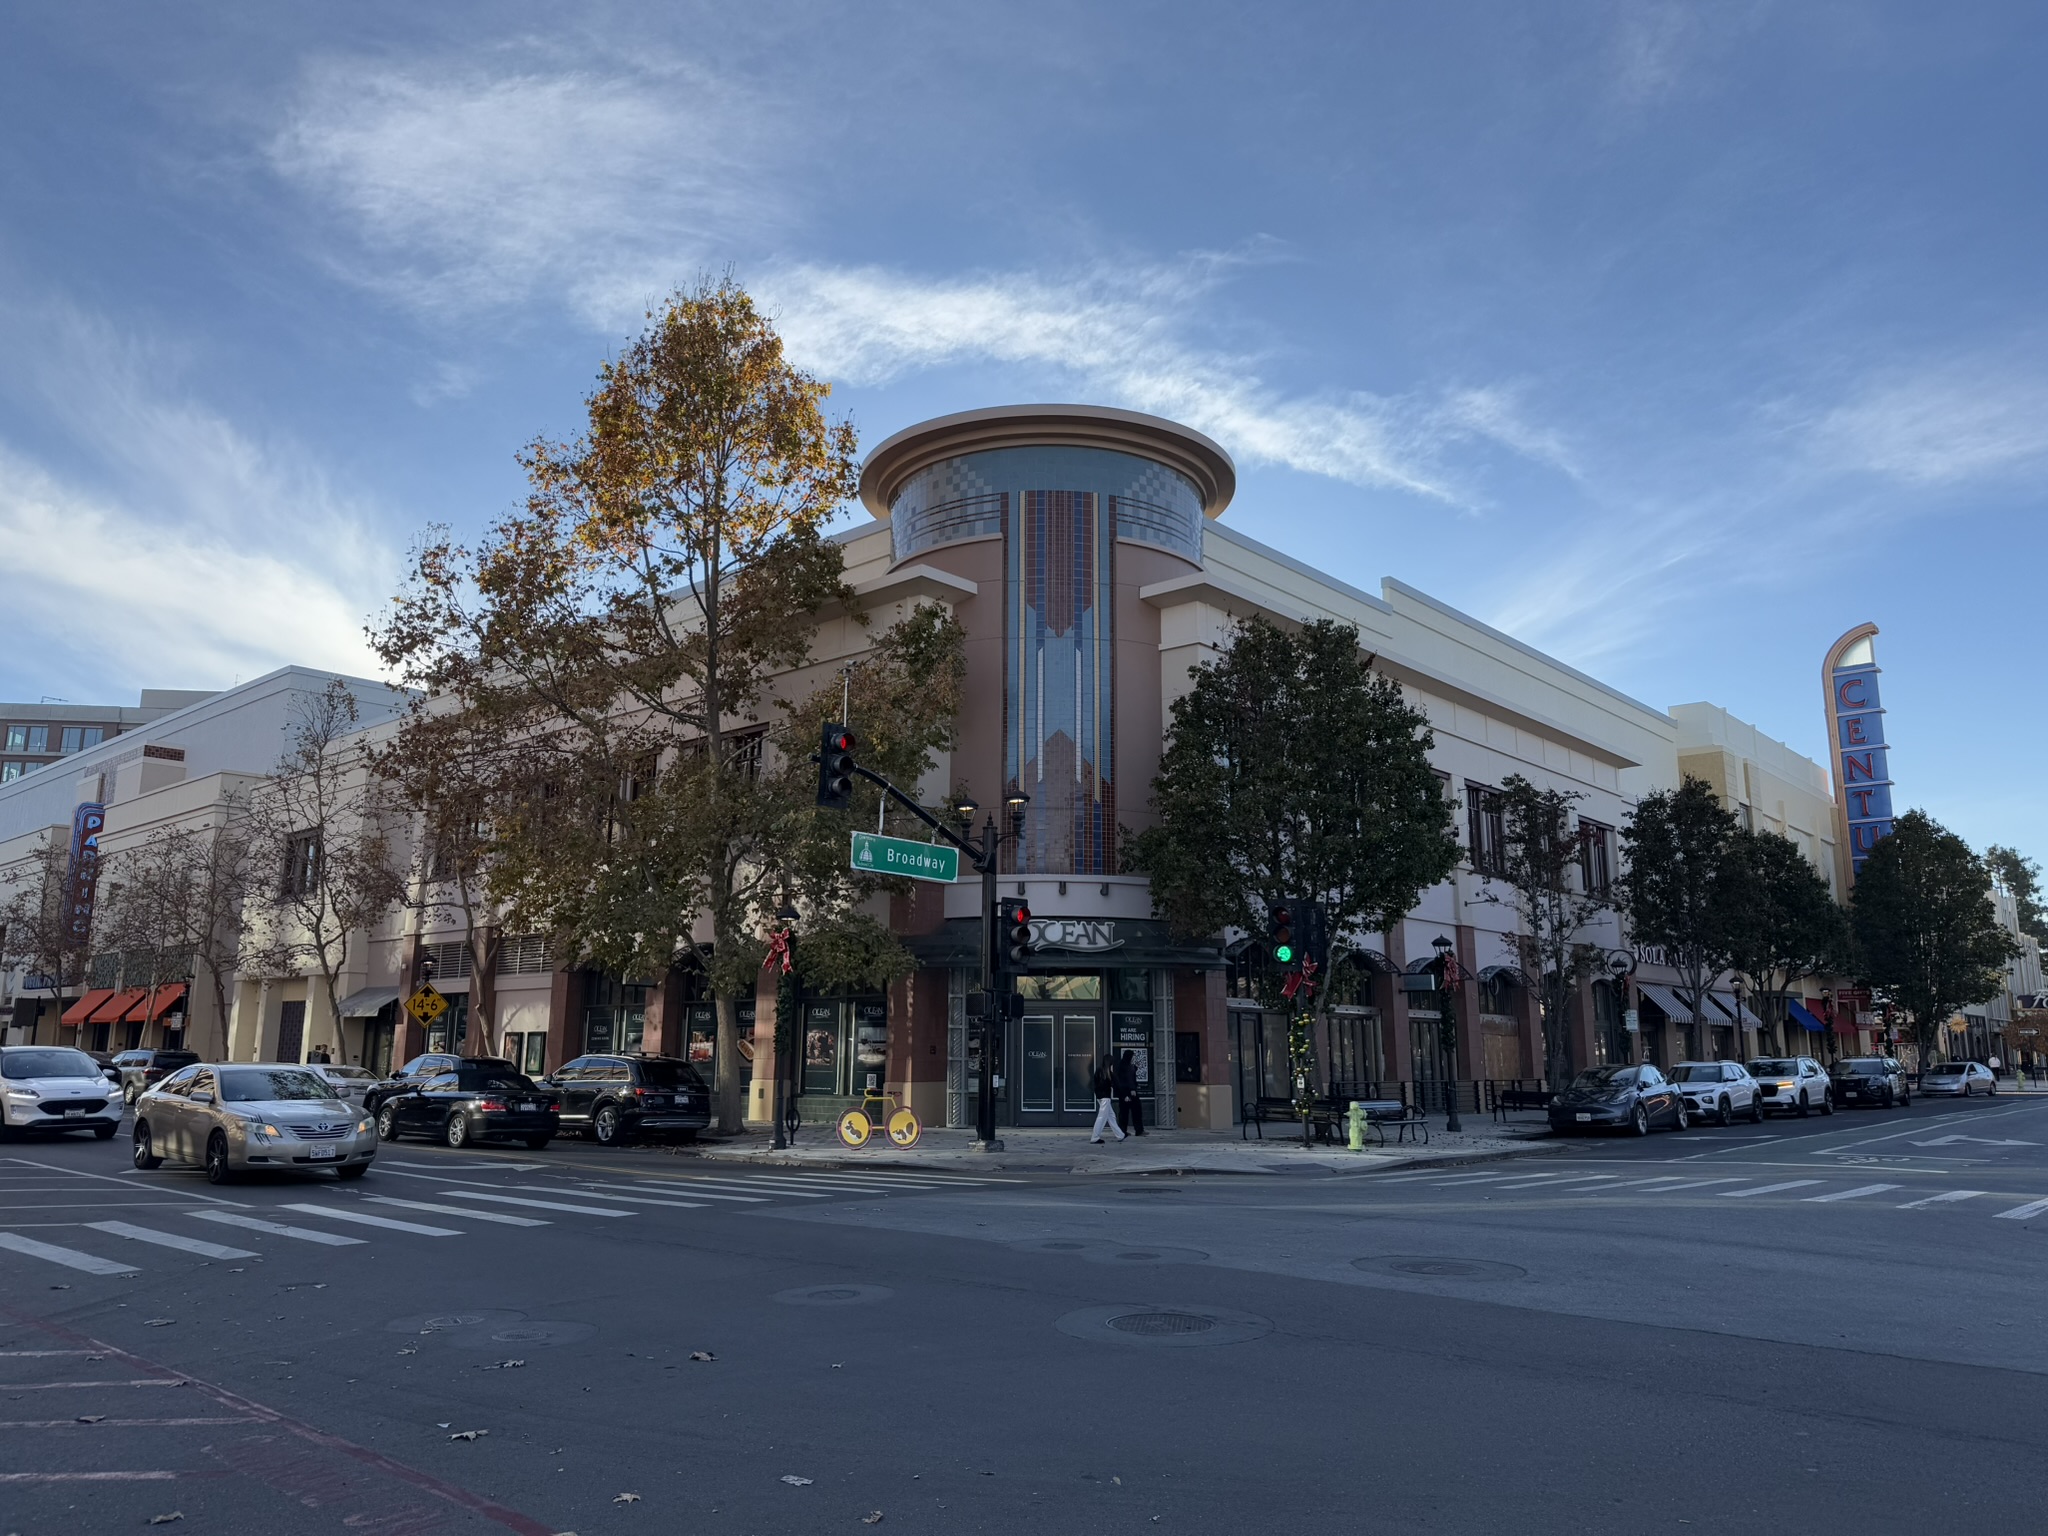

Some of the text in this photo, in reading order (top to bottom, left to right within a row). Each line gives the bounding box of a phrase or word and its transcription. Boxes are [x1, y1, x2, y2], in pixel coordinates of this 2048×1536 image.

[887, 848, 946, 873] Broadway
[73, 815, 102, 934] PARKING
[1639, 944, 1666, 966] SOLA
